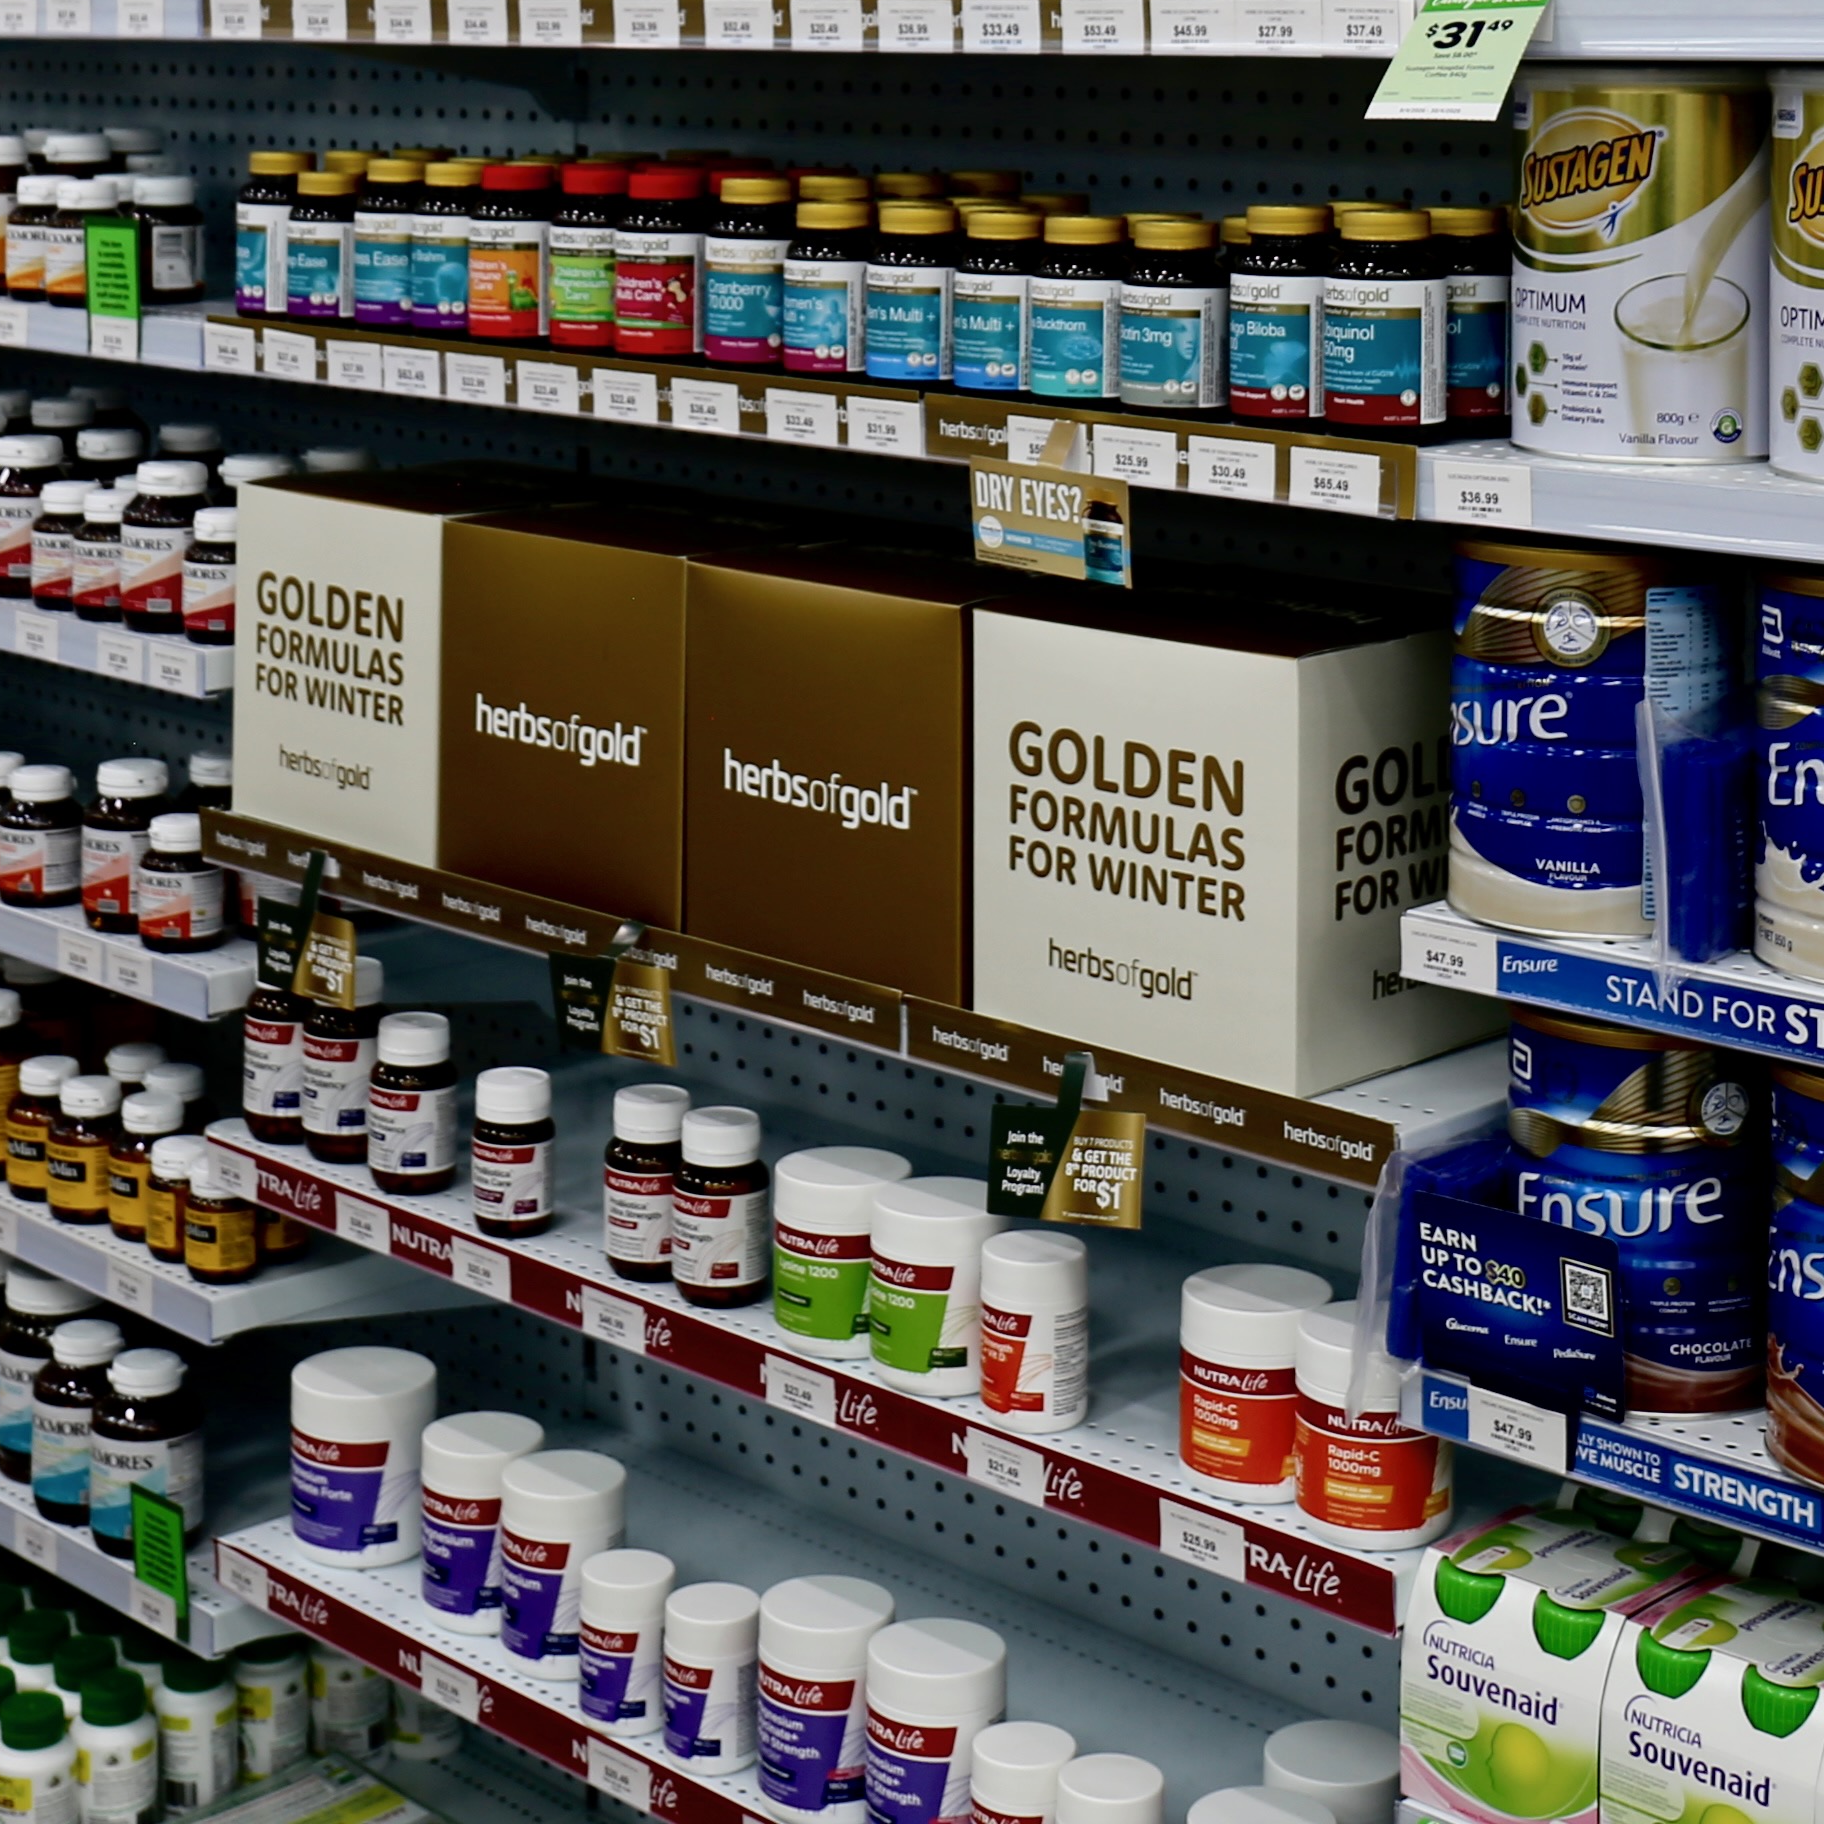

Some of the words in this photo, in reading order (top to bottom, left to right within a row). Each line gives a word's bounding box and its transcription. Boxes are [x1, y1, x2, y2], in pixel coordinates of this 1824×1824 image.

[1346, 24, 1382, 38] $37.49
[707, 279, 772, 300] Cranberry
[1248, 321, 1286, 338] Biloba
[975, 470, 1016, 514] DRY
[1020, 476, 1083, 524] EYES?
[1312, 474, 1349, 494] $65.49
[1460, 490, 1499, 506] $36.99
[256, 570, 405, 644] GOLDEN
[255, 622, 405, 687] FORMULAS
[255, 663, 299, 698] FOR
[304, 676, 405, 727] WINTER
[1007, 720, 1245, 818] GOLDEN
[1008, 783, 1247, 873] FORMULAS
[1007, 834, 1078, 886] FOR
[1087, 854, 1247, 923] WINTER
[1425, 949, 1464, 968] $47.99
[1605, 975, 1705, 1019] STAND
[1711, 997, 1776, 1035] FOR
[806, 1263, 839, 1280] 1200
[1327, 1443, 1380, 1464] Rapid-C
[1327, 1457, 1382, 1477] 1000mg
[1674, 1463, 1815, 1528] STRENGTH
[1182, 1530, 1217, 1553] $25.99
[1426, 1653, 1560, 1727] Souvenaid
[1631, 1704, 1703, 1750] NUTRICIA
[1628, 1729, 1770, 1807] Souvenaid
